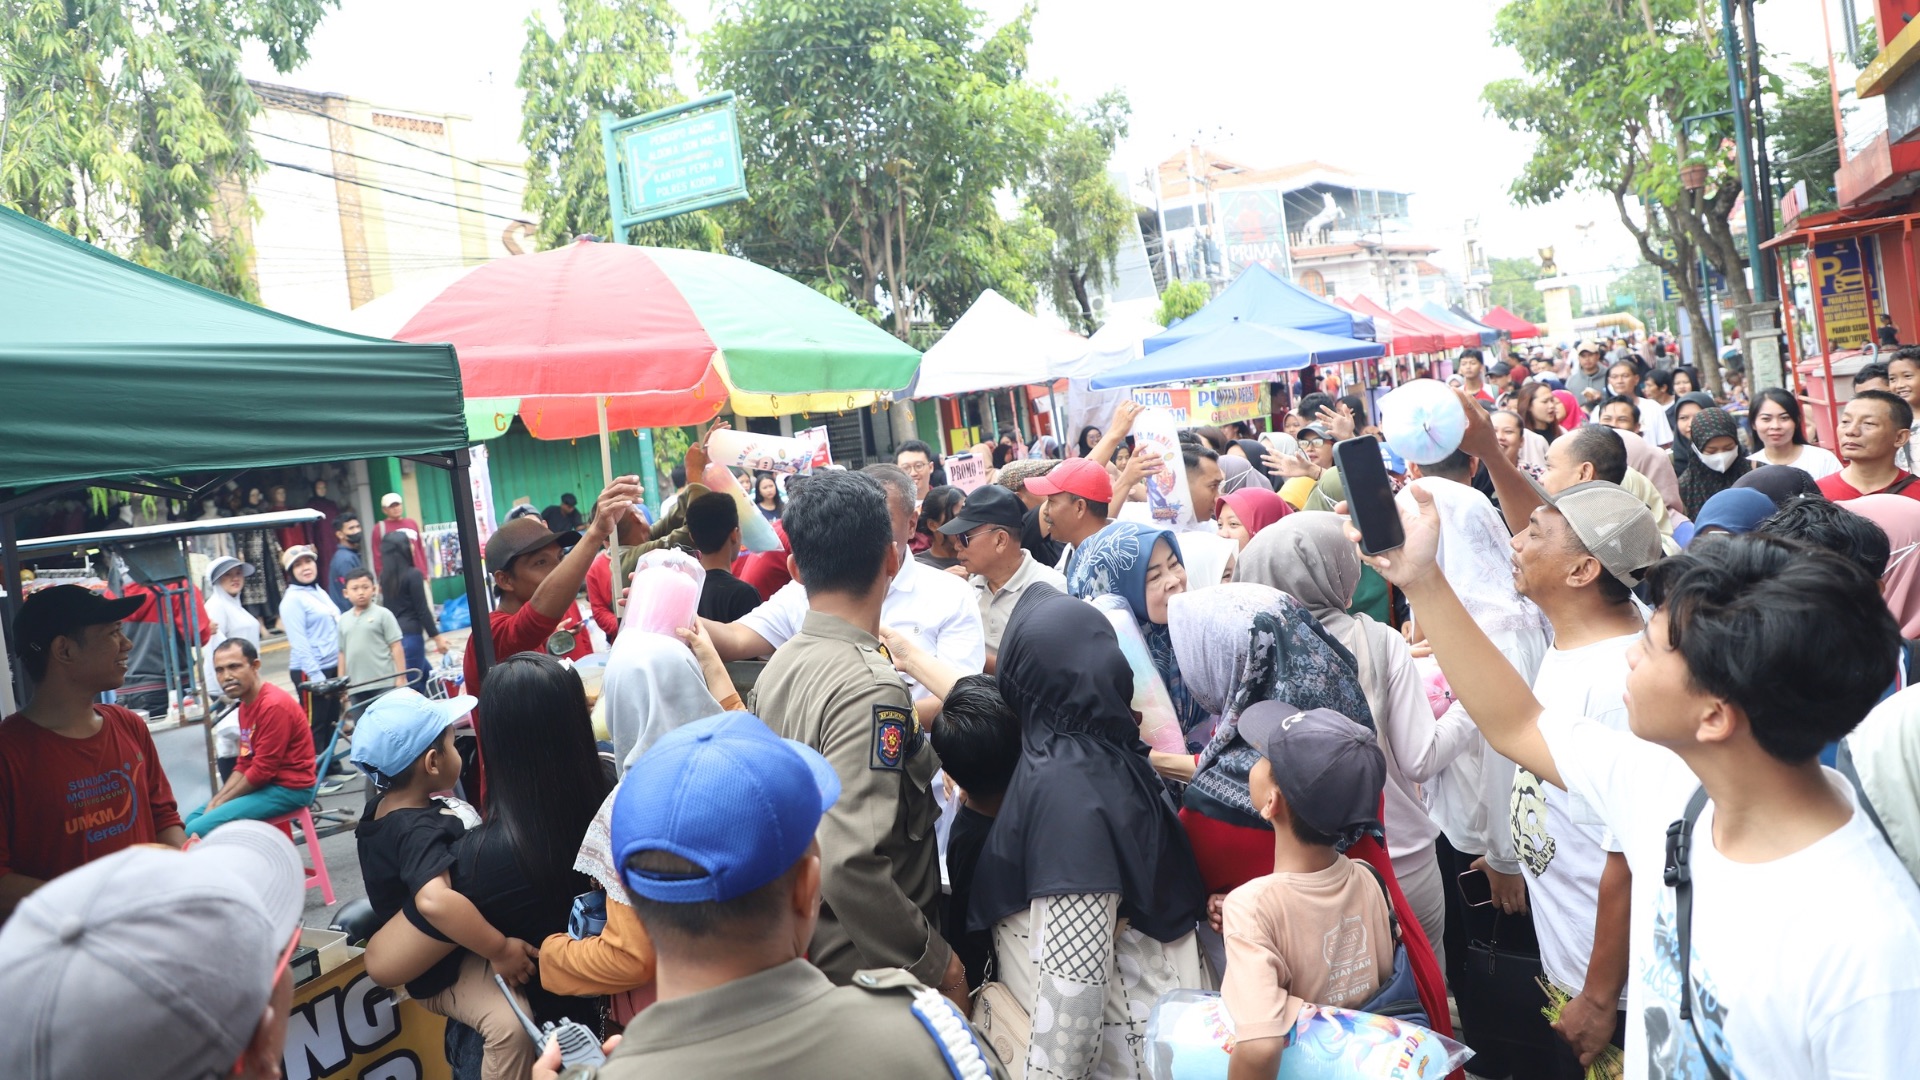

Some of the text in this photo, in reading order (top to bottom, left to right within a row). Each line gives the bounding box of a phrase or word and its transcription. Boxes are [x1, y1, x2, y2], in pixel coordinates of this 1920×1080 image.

[654, 167, 687, 183] KANTOR
[656, 175, 717, 198] POLRES KODIM
[1230, 242, 1283, 261] PRIMA
[950, 462, 977, 482] PROMO
[68, 771, 112, 791] SUNDAY
[66, 780, 120, 803] MORNING
[65, 807, 116, 835] UMKM
